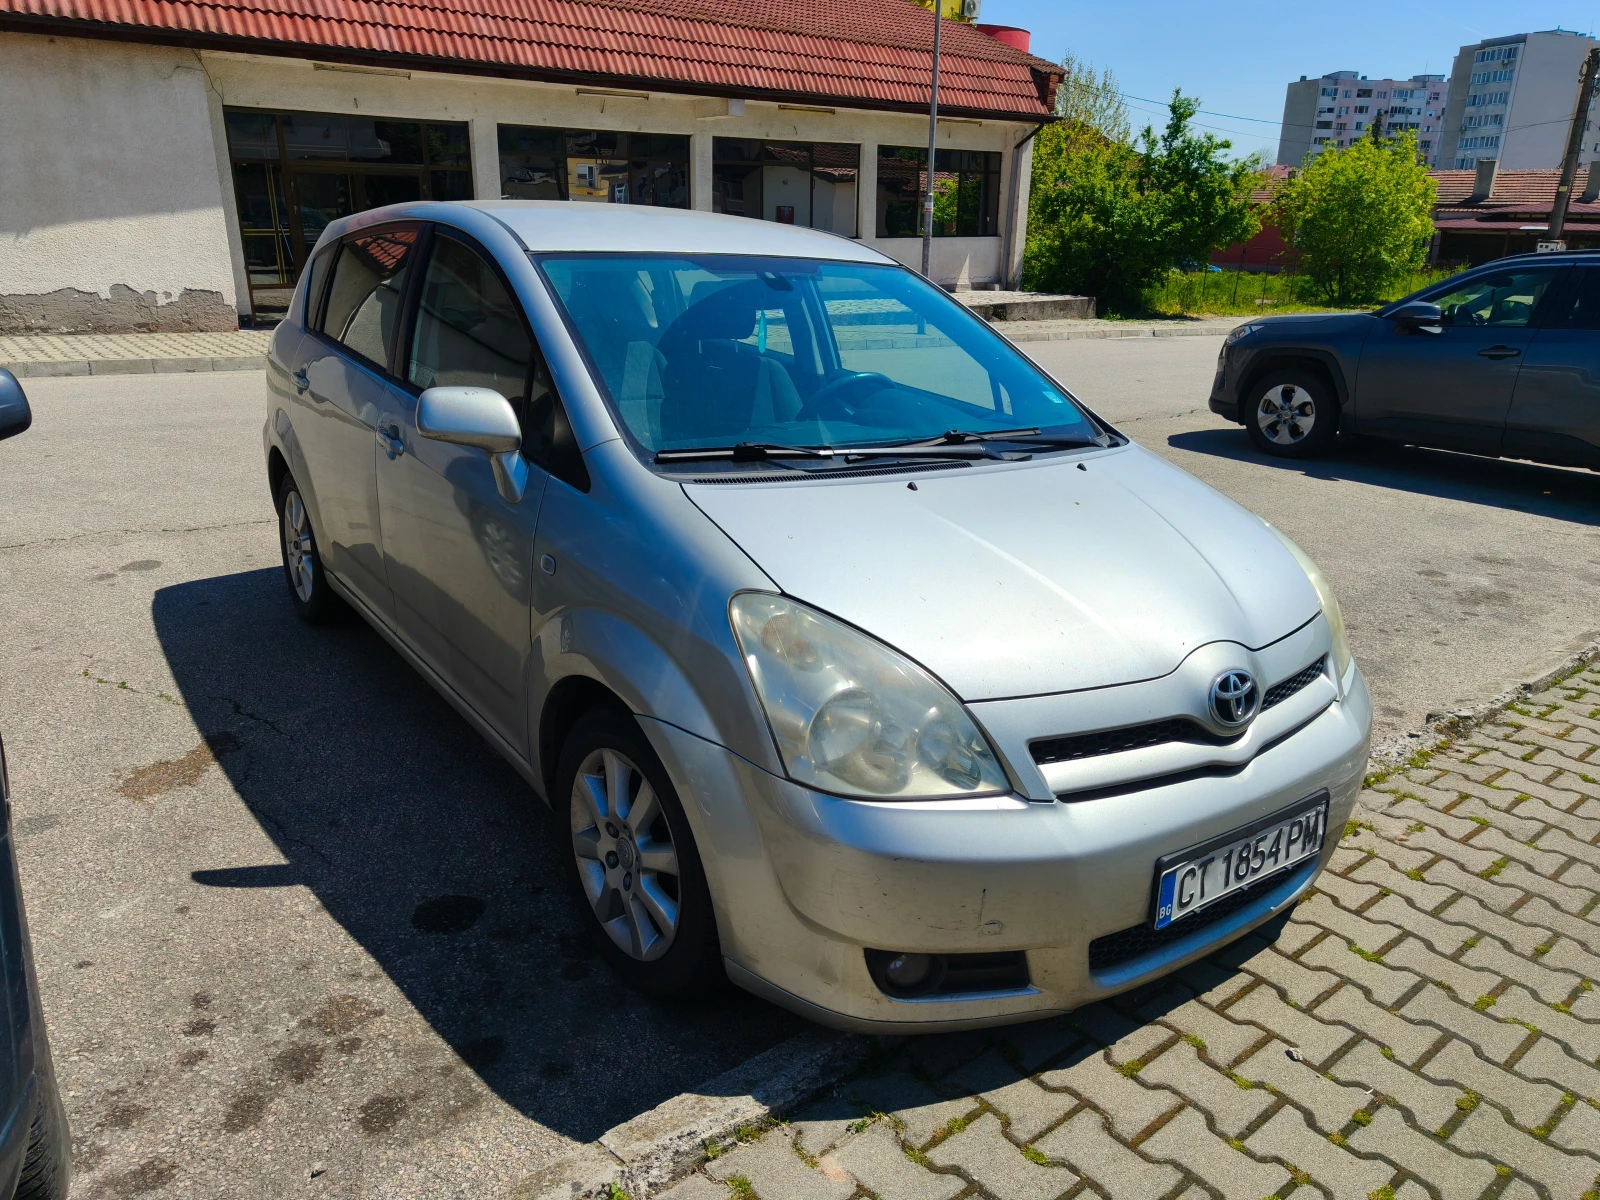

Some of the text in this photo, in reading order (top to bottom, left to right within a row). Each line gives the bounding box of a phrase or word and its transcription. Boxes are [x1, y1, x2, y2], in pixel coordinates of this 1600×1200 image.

[1177, 810, 1320, 911] CT 1854 PM
[1159, 904, 1172, 919] BG
